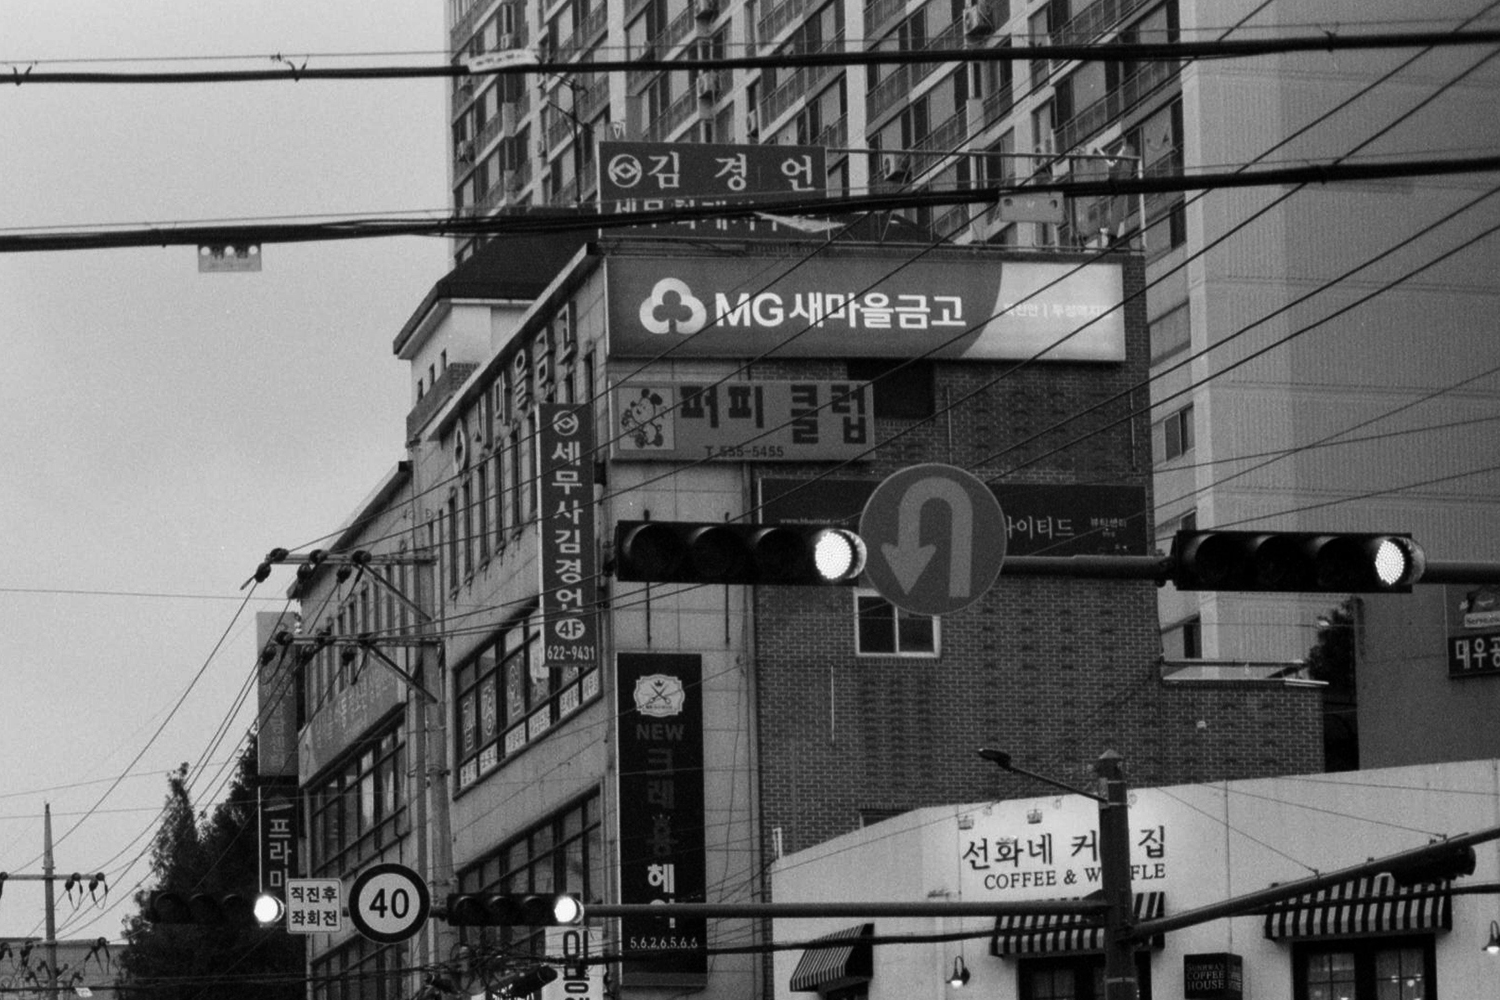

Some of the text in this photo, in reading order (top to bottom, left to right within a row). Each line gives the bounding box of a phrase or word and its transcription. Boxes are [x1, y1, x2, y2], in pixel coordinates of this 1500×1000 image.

[715, 291, 968, 330] MG 새마을금고
[680, 384, 868, 445] 퍼피 클럽
[558, 621, 582, 636] 4F
[547, 645, 595, 661] 622-9431
[636, 723, 685, 741] NEW
[962, 826, 1166, 870] 선화네 커집
[984, 863, 1166, 890] COFFEE & WFLE
[290, 885, 338, 903] 직진후
[369, 887, 410, 920] 40
[290, 908, 338, 927] 좌회전
